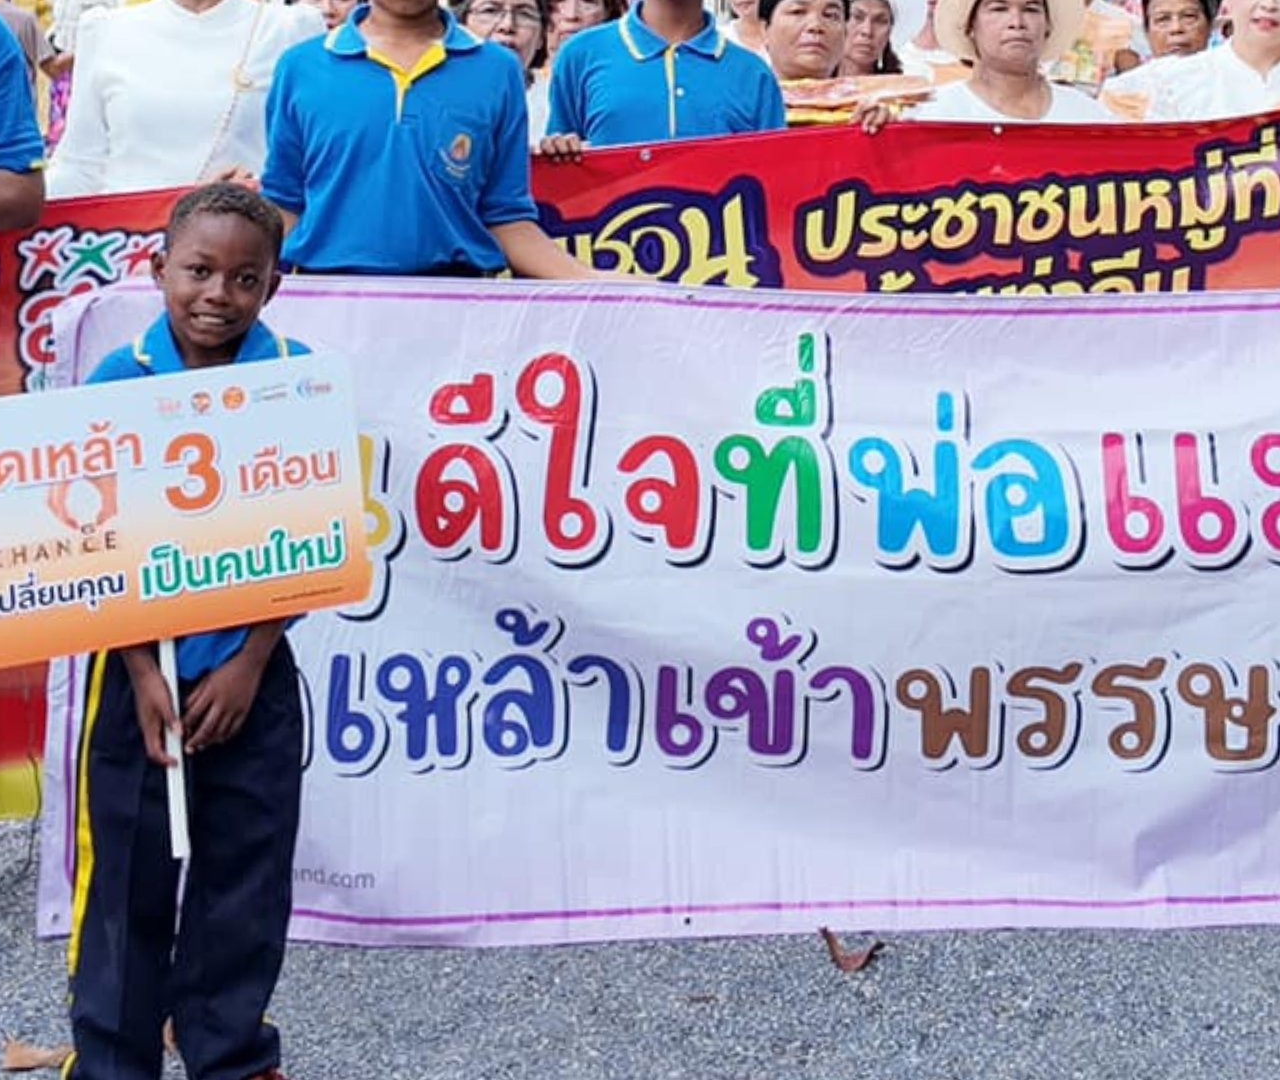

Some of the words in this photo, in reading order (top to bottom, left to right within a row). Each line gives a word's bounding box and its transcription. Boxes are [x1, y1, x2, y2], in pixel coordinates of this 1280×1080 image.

[164, 432, 223, 512] 3
[238, 446, 340, 494] เดือน
[141, 522, 346, 597] เป็นคนใหม่
